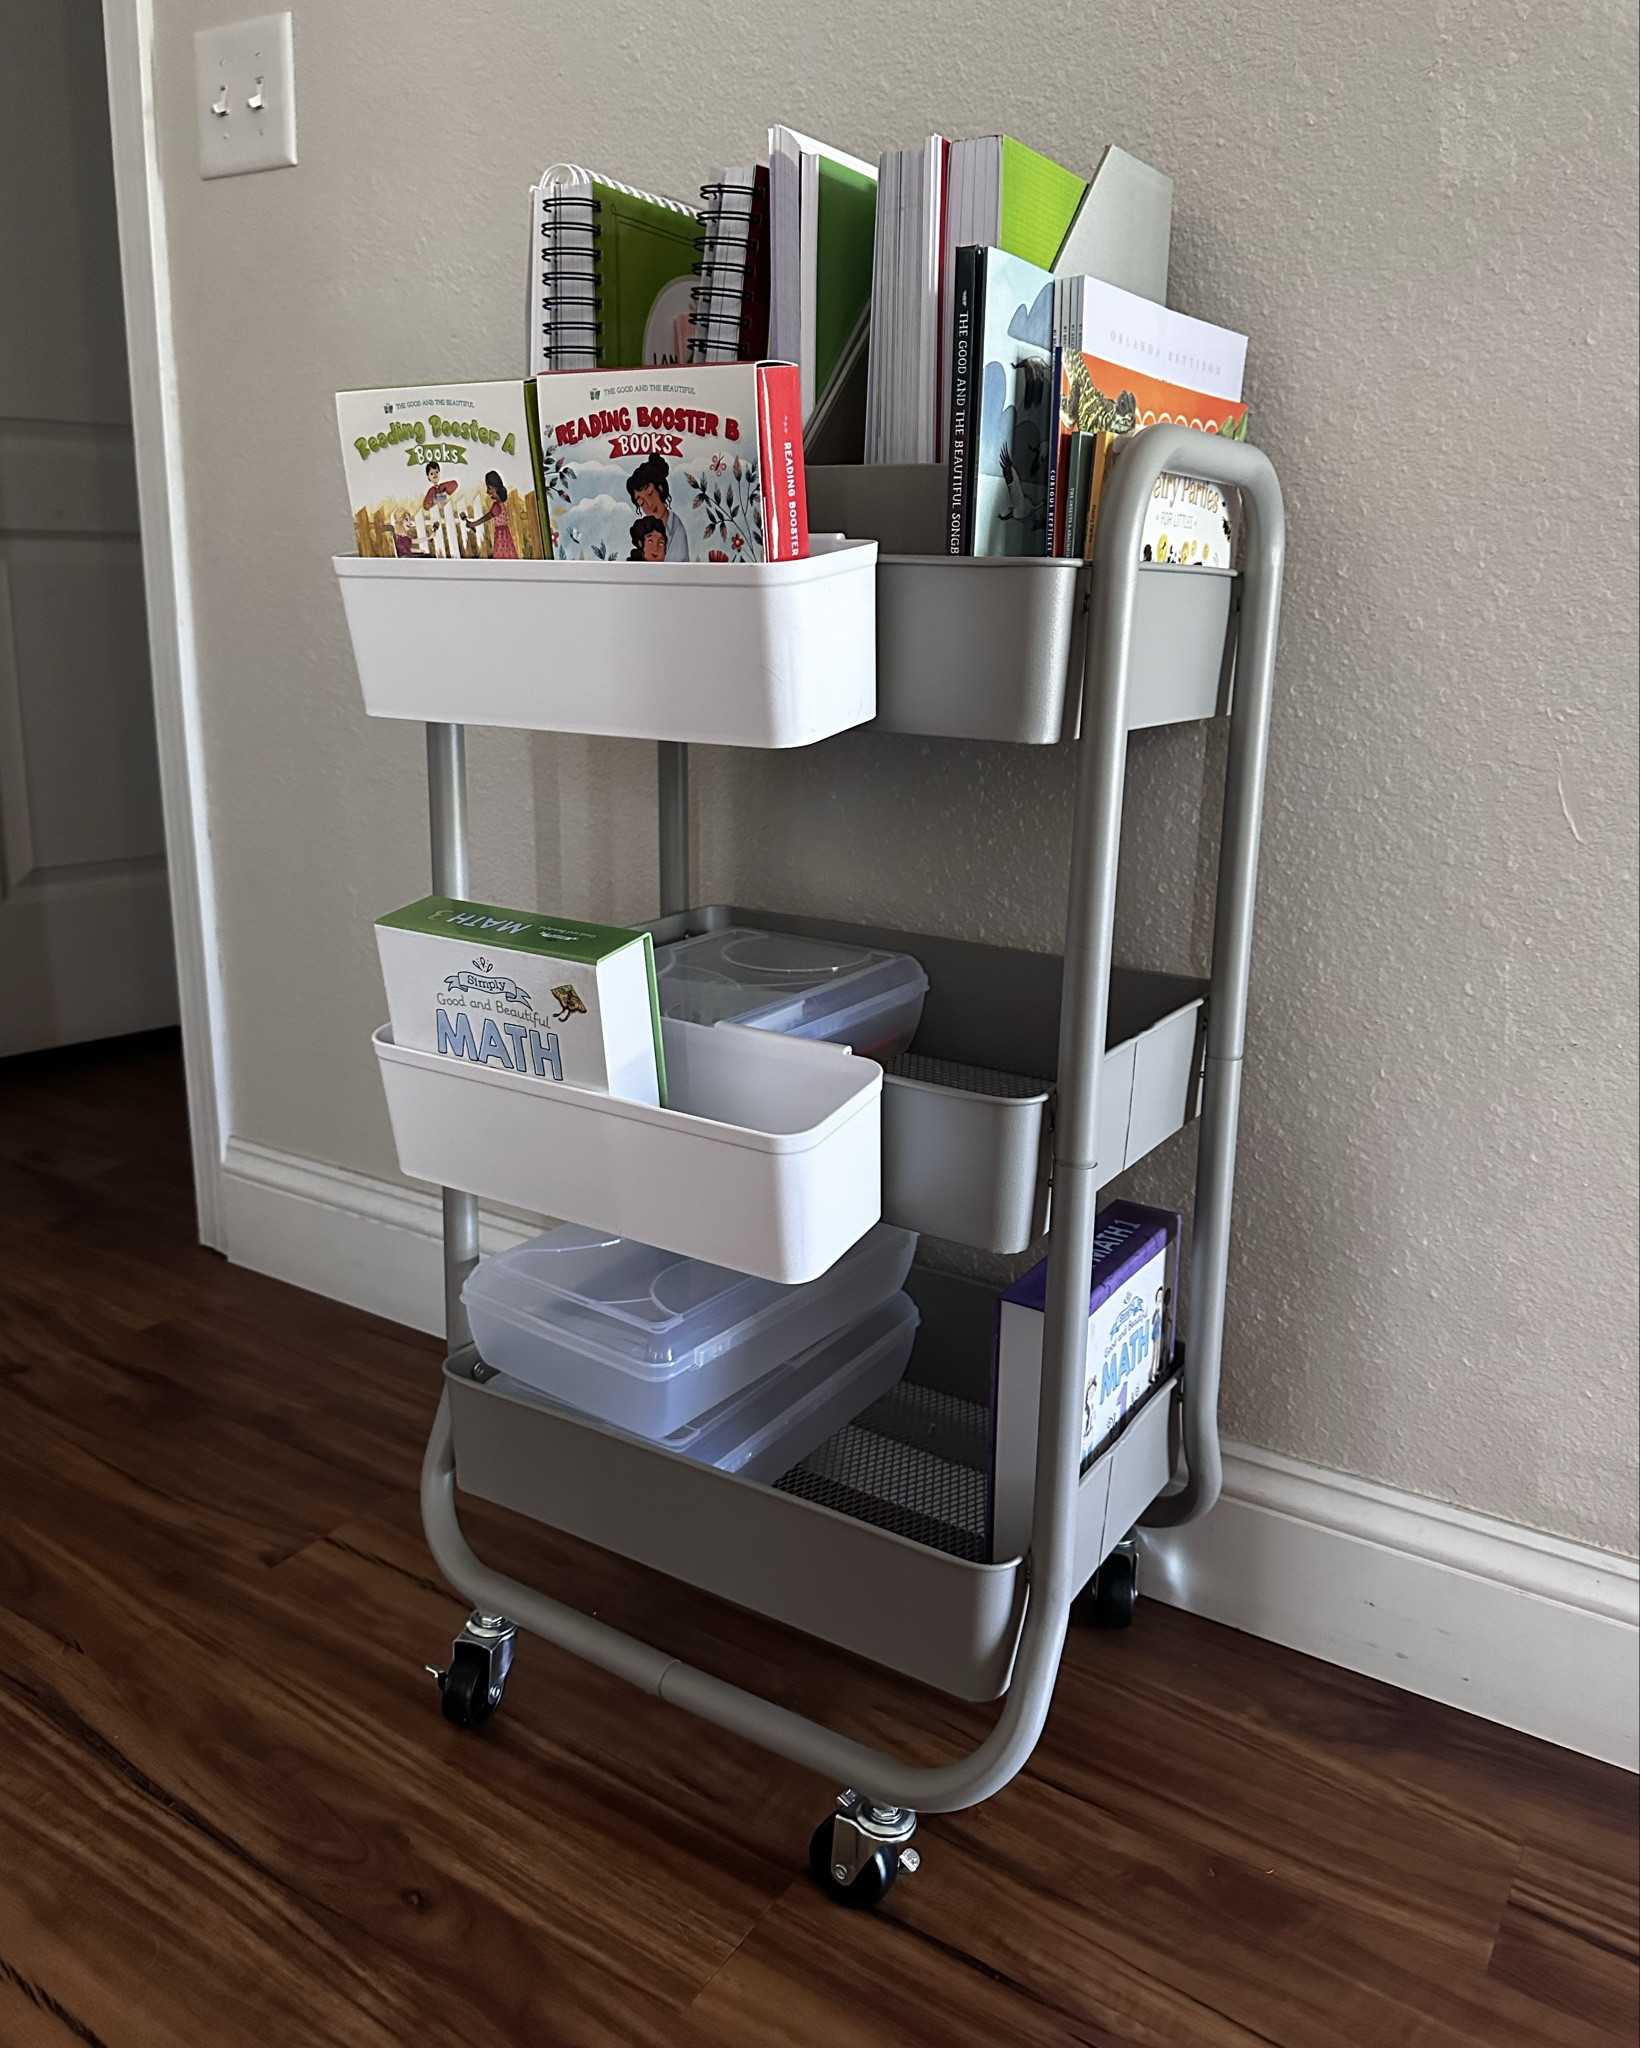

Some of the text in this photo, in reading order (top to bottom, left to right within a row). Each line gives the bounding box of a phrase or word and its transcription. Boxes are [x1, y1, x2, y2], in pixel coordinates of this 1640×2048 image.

[959, 310, 969, 337] THE
[957, 338, 967, 375] GOOD
[1110, 330, 1160, 358] ORLANDA
[407, 400, 421, 408] GOOD
[446, 399, 475, 408] BEAUTIFUL
[603, 388, 616, 396] THE
[616, 386, 633, 394] GOOD
[650, 384, 662, 392] THE
[662, 385, 696, 395] BEAUTIFUL
[956, 378, 966, 406] AND
[354, 414, 515, 460] Reading Booster A
[555, 406, 740, 447] READING BOOSTER B
[955, 409, 965, 436] THE
[414, 443, 459, 465] Books
[617, 432, 673, 455] BOOKS
[952, 440, 964, 510] BEAUTIFUL
[783, 441, 799, 556] READING BOOSTER
[1181, 476, 1220, 514] Parties
[427, 909, 533, 934] MATH 3
[466, 974, 507, 992] Simply
[436, 992, 551, 1029] Good and Beautiful
[435, 1008, 564, 1081] MATH
[1092, 1225, 1134, 1263] MATH
[1100, 1318, 1150, 1406] MATH
